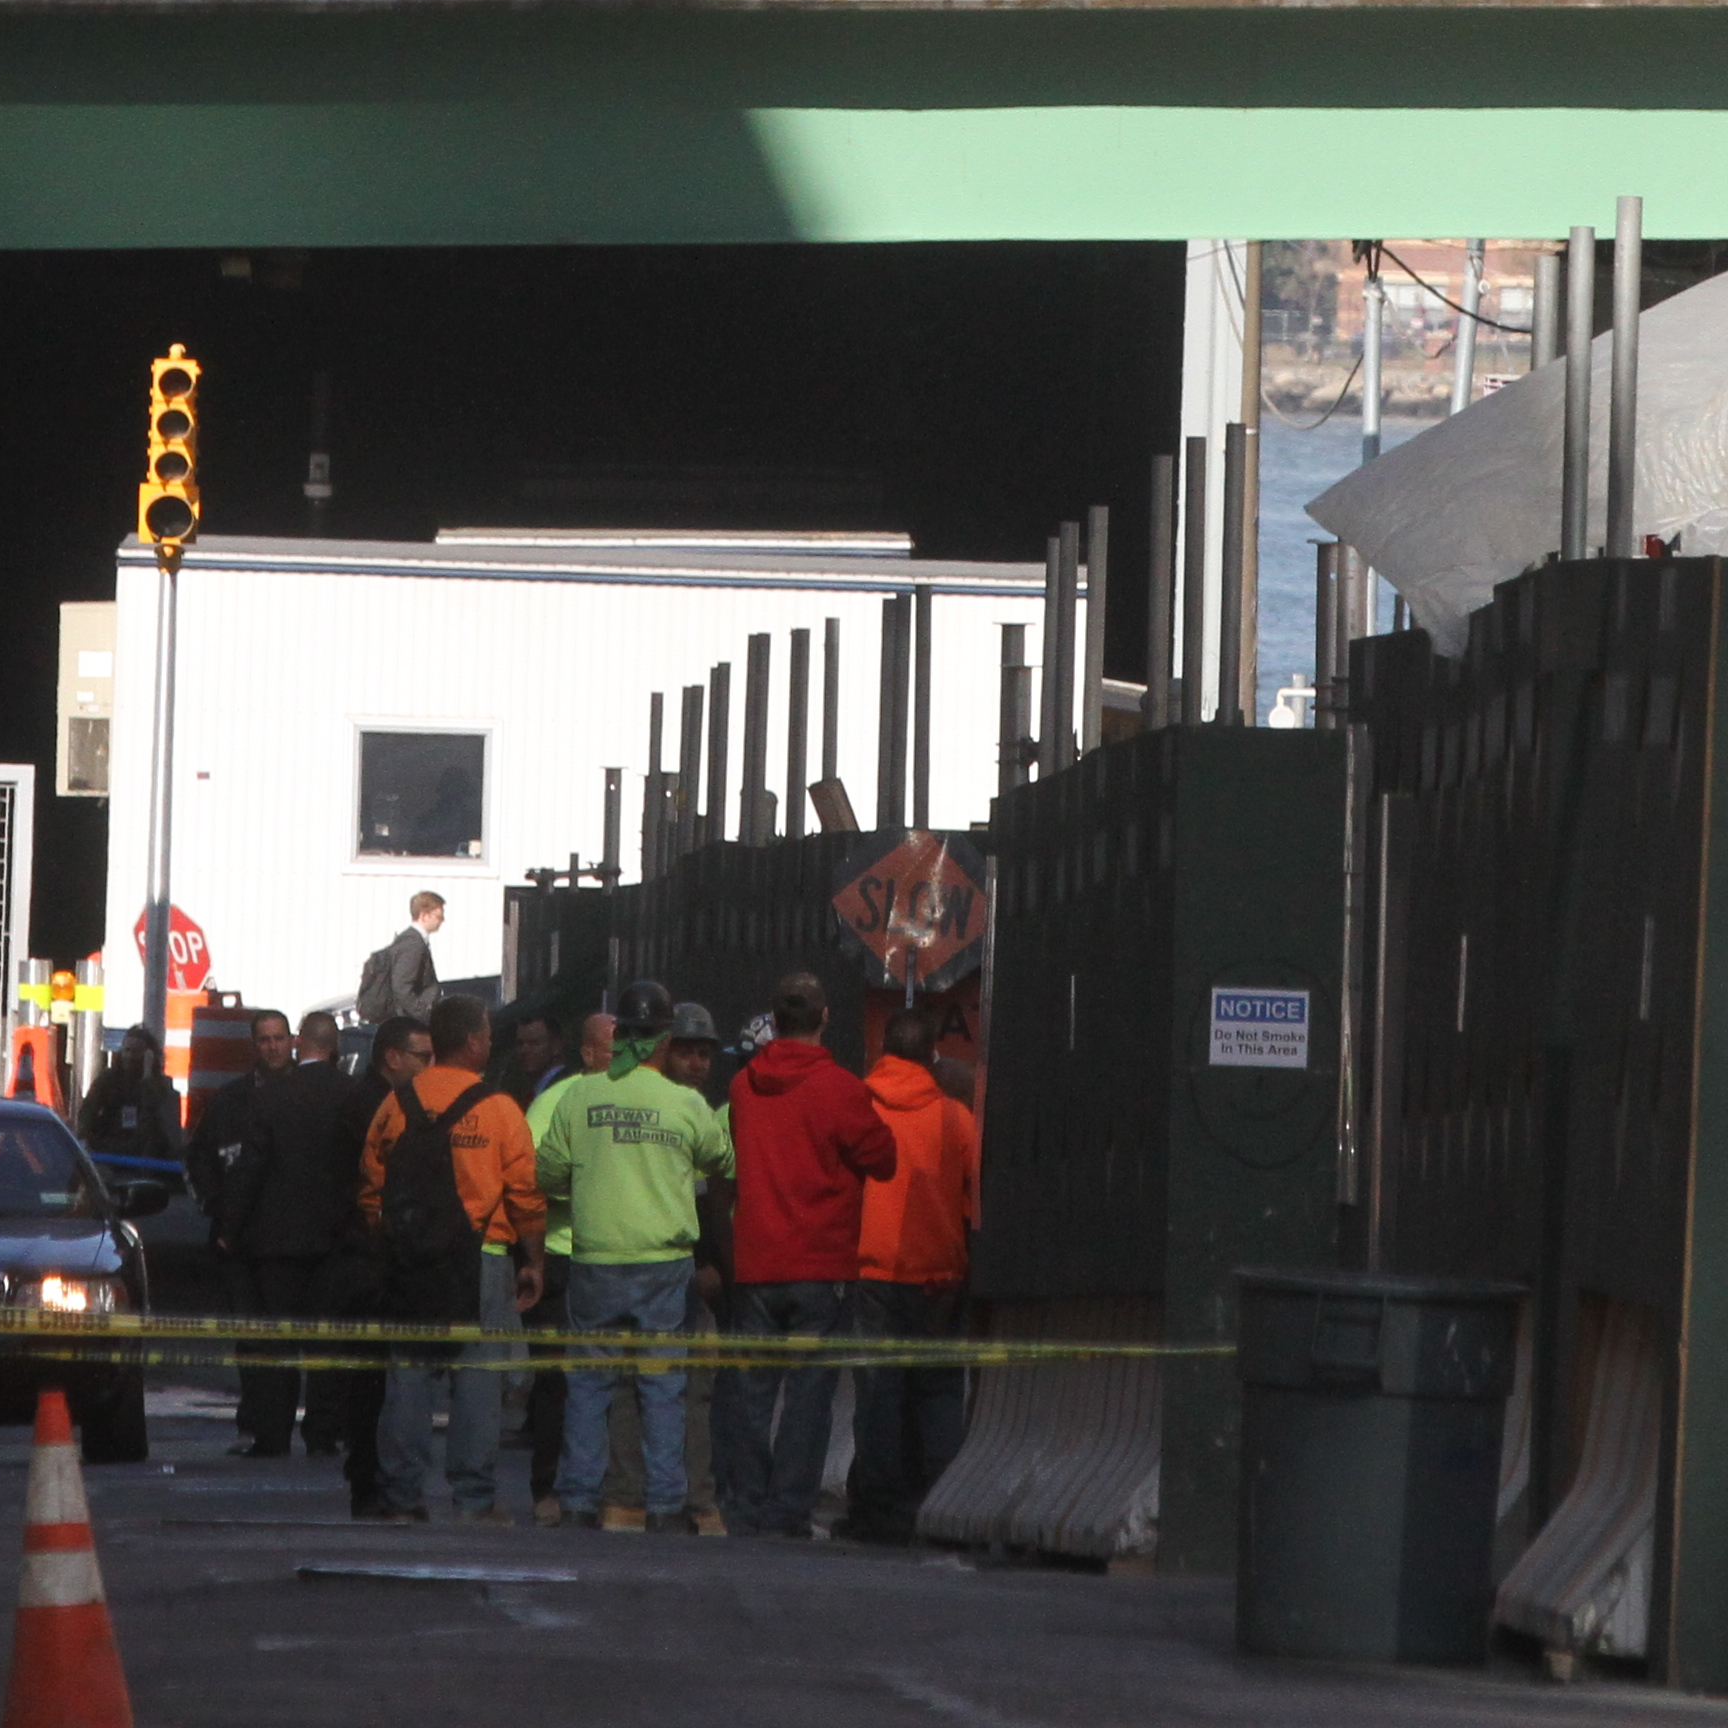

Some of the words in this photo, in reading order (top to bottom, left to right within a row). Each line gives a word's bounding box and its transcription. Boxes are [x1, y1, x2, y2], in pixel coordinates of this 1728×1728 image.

[1220, 999, 1301, 1019] NOTICE
[1214, 1029, 1232, 1041] Do
[1236, 1030, 1258, 1042] Not
[1261, 1031, 1306, 1043] Smoke
[1221, 1043, 1233, 1054] In
[1238, 1044, 1264, 1055] This
[1267, 1045, 1298, 1056] Area
